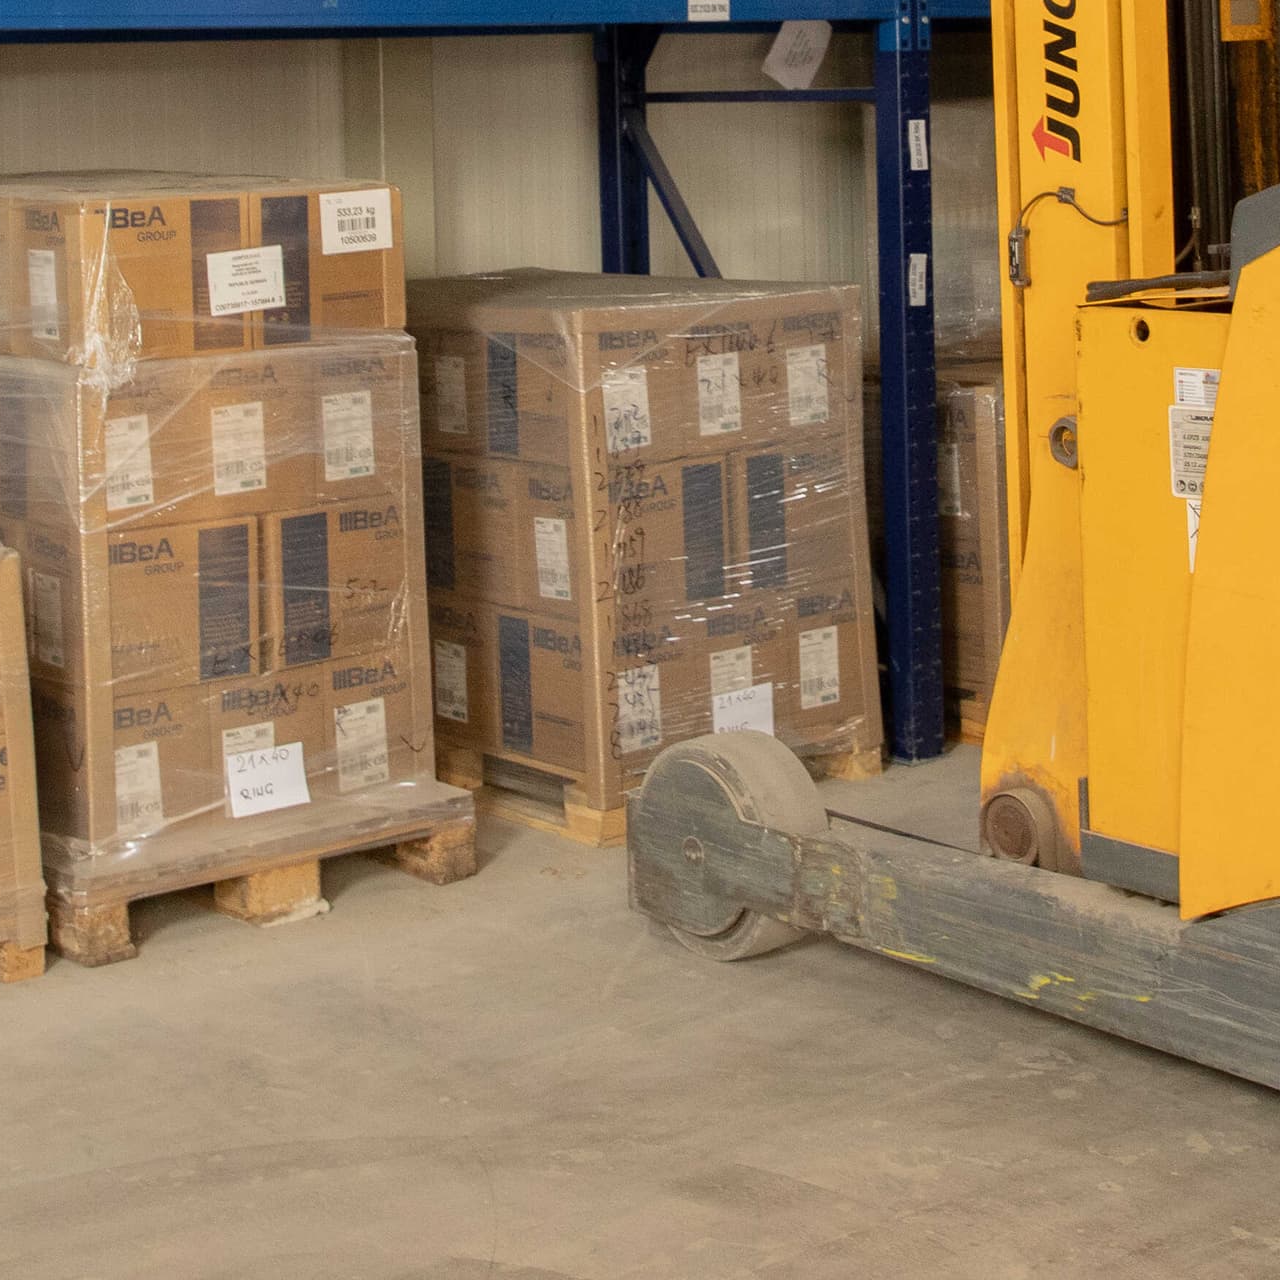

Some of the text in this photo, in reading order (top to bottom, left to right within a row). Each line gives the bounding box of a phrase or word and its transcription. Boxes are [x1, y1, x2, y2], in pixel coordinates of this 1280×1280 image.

[137, 231, 176, 242] GROUP
[145, 562, 183, 575] GROUP
[240, 783, 273, 800] RING
